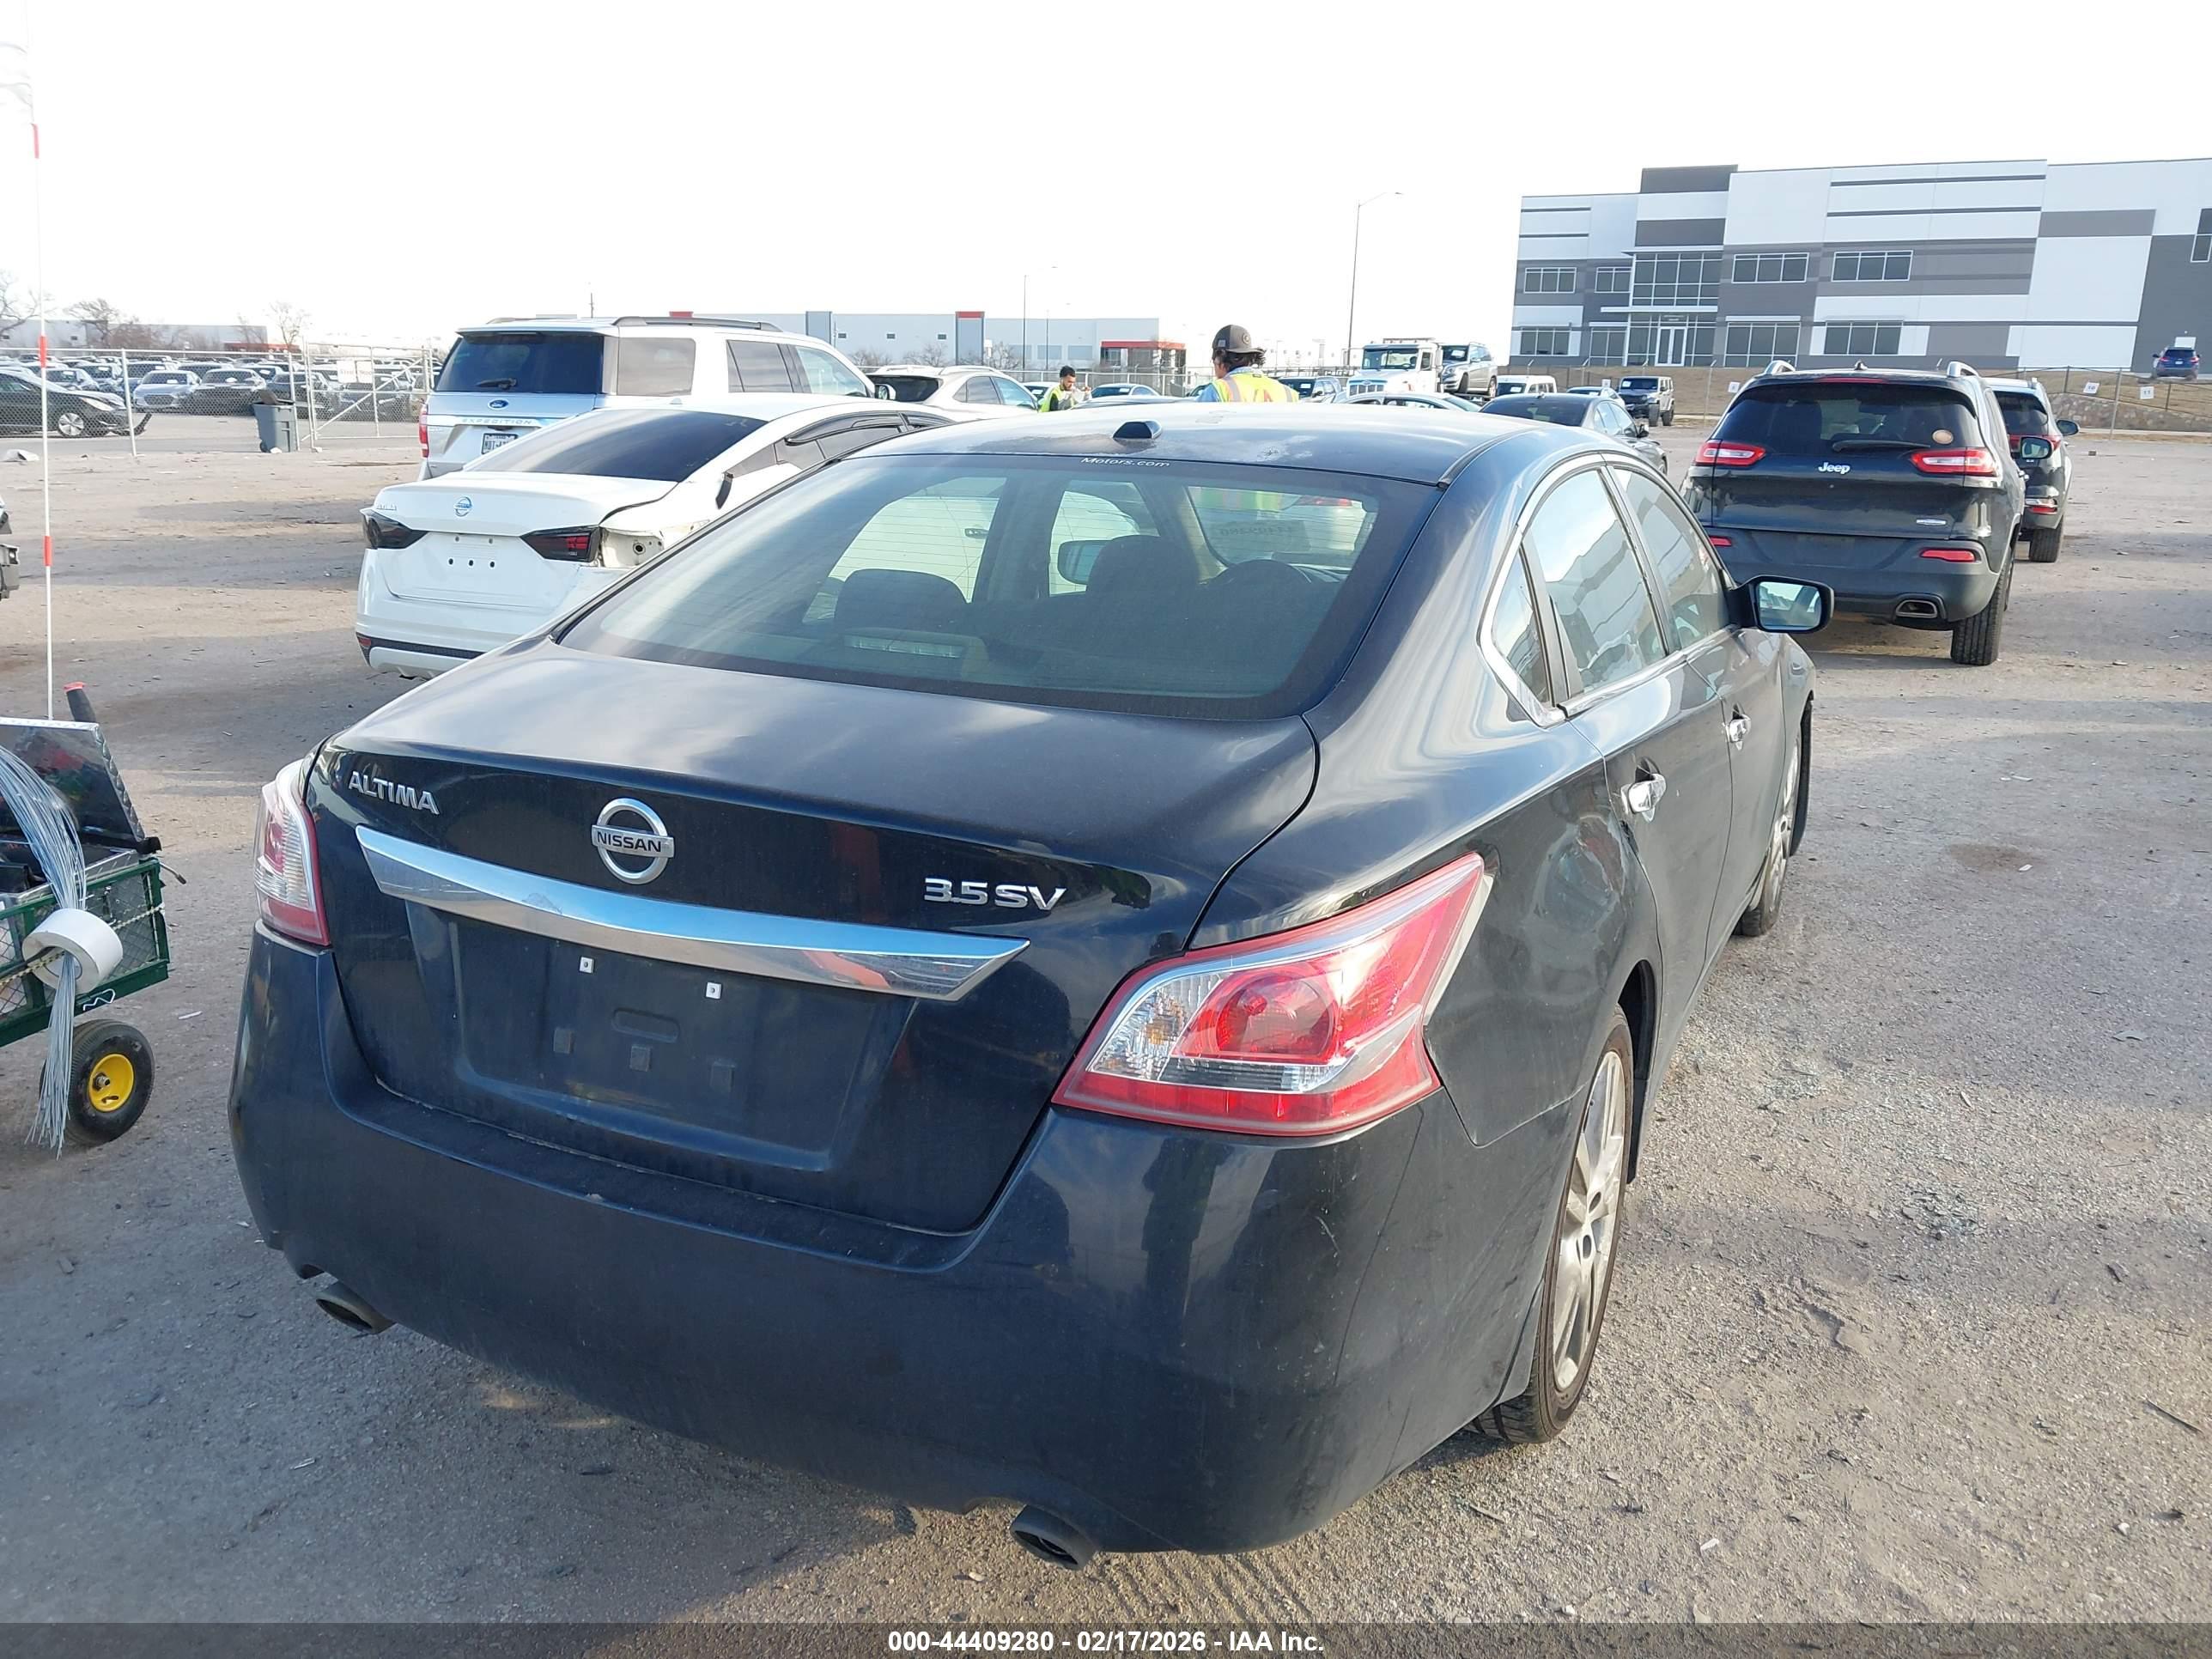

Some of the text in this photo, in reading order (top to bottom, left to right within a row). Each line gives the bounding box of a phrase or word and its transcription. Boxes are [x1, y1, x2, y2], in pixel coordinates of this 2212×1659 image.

[1081, 457, 1170, 467] Motors.com
[1818, 461, 1851, 475] Jeep
[348, 770, 440, 815] ALTIMA
[597, 831, 661, 853] NISSAN
[924, 878, 1067, 911] 3.5 SV
